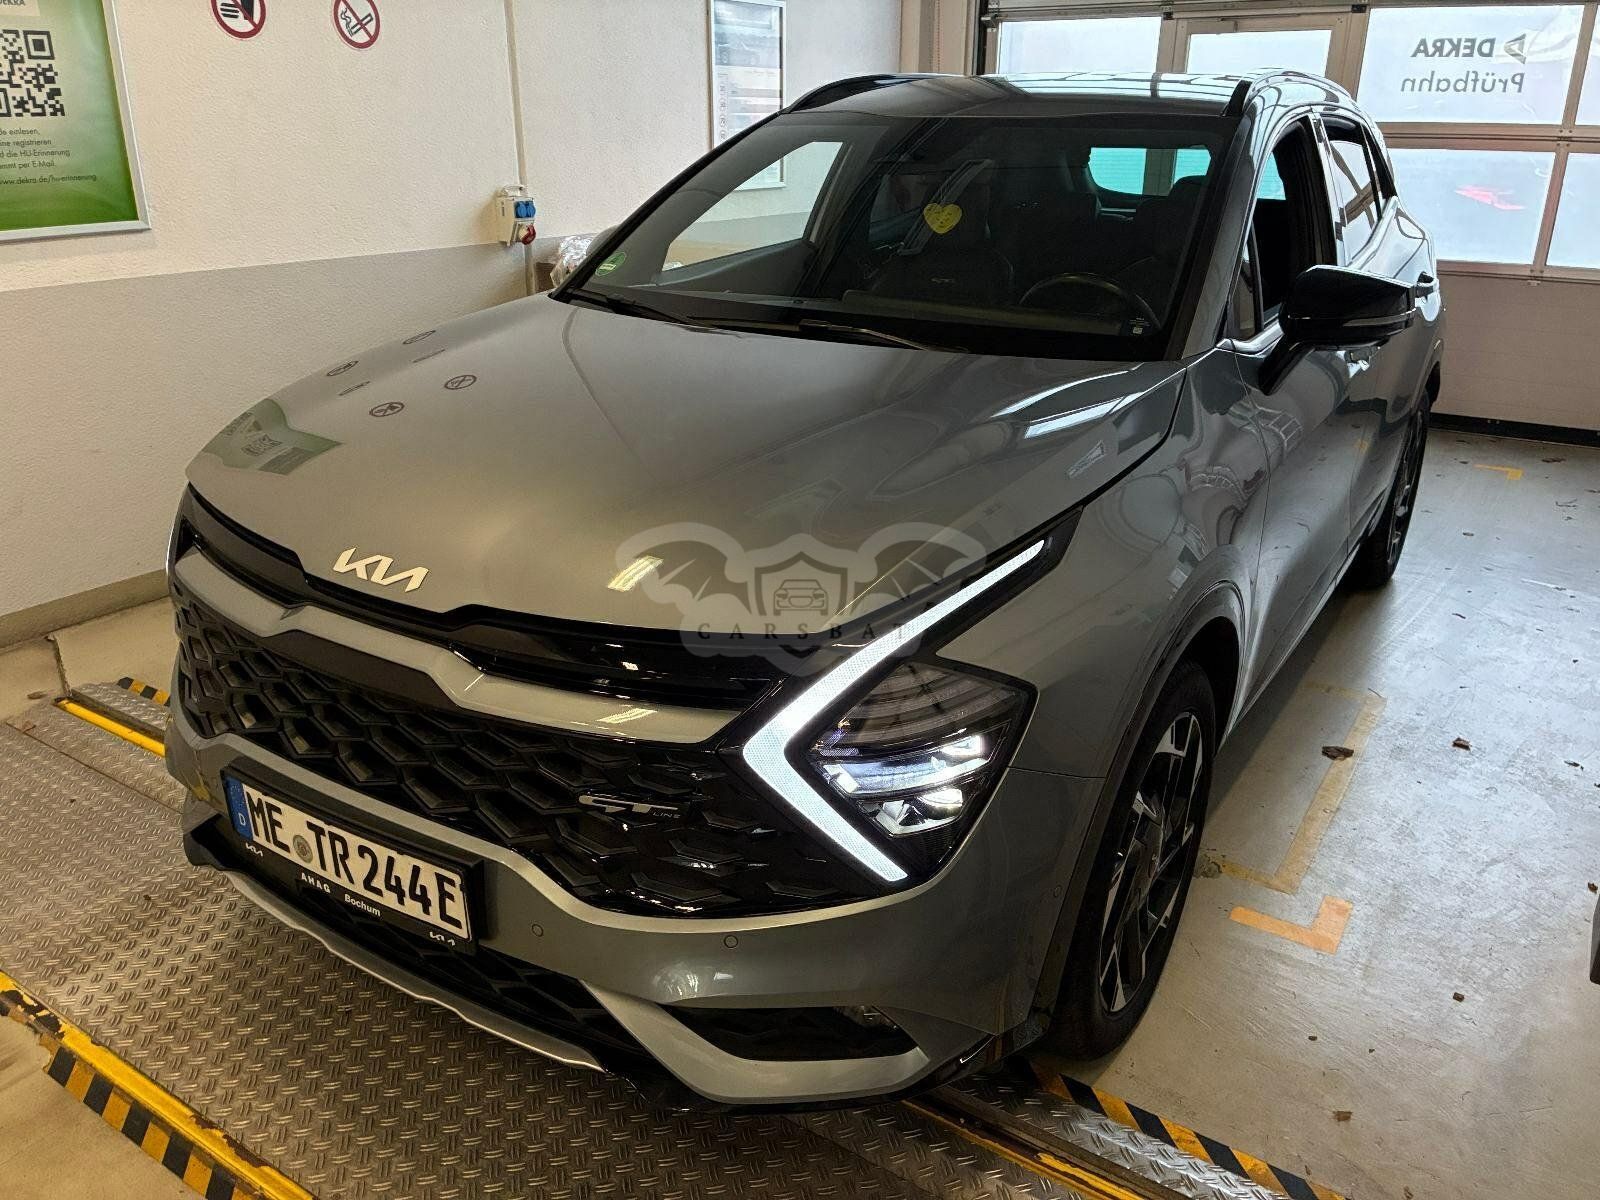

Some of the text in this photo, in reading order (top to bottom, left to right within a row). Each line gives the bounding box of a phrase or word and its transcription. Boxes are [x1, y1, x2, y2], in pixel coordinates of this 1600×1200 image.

[13, 138, 52, 148] registrieren
[238, 812, 247, 827] D
[246, 791, 291, 855] ME
[300, 872, 381, 917] AHAG Bochum
